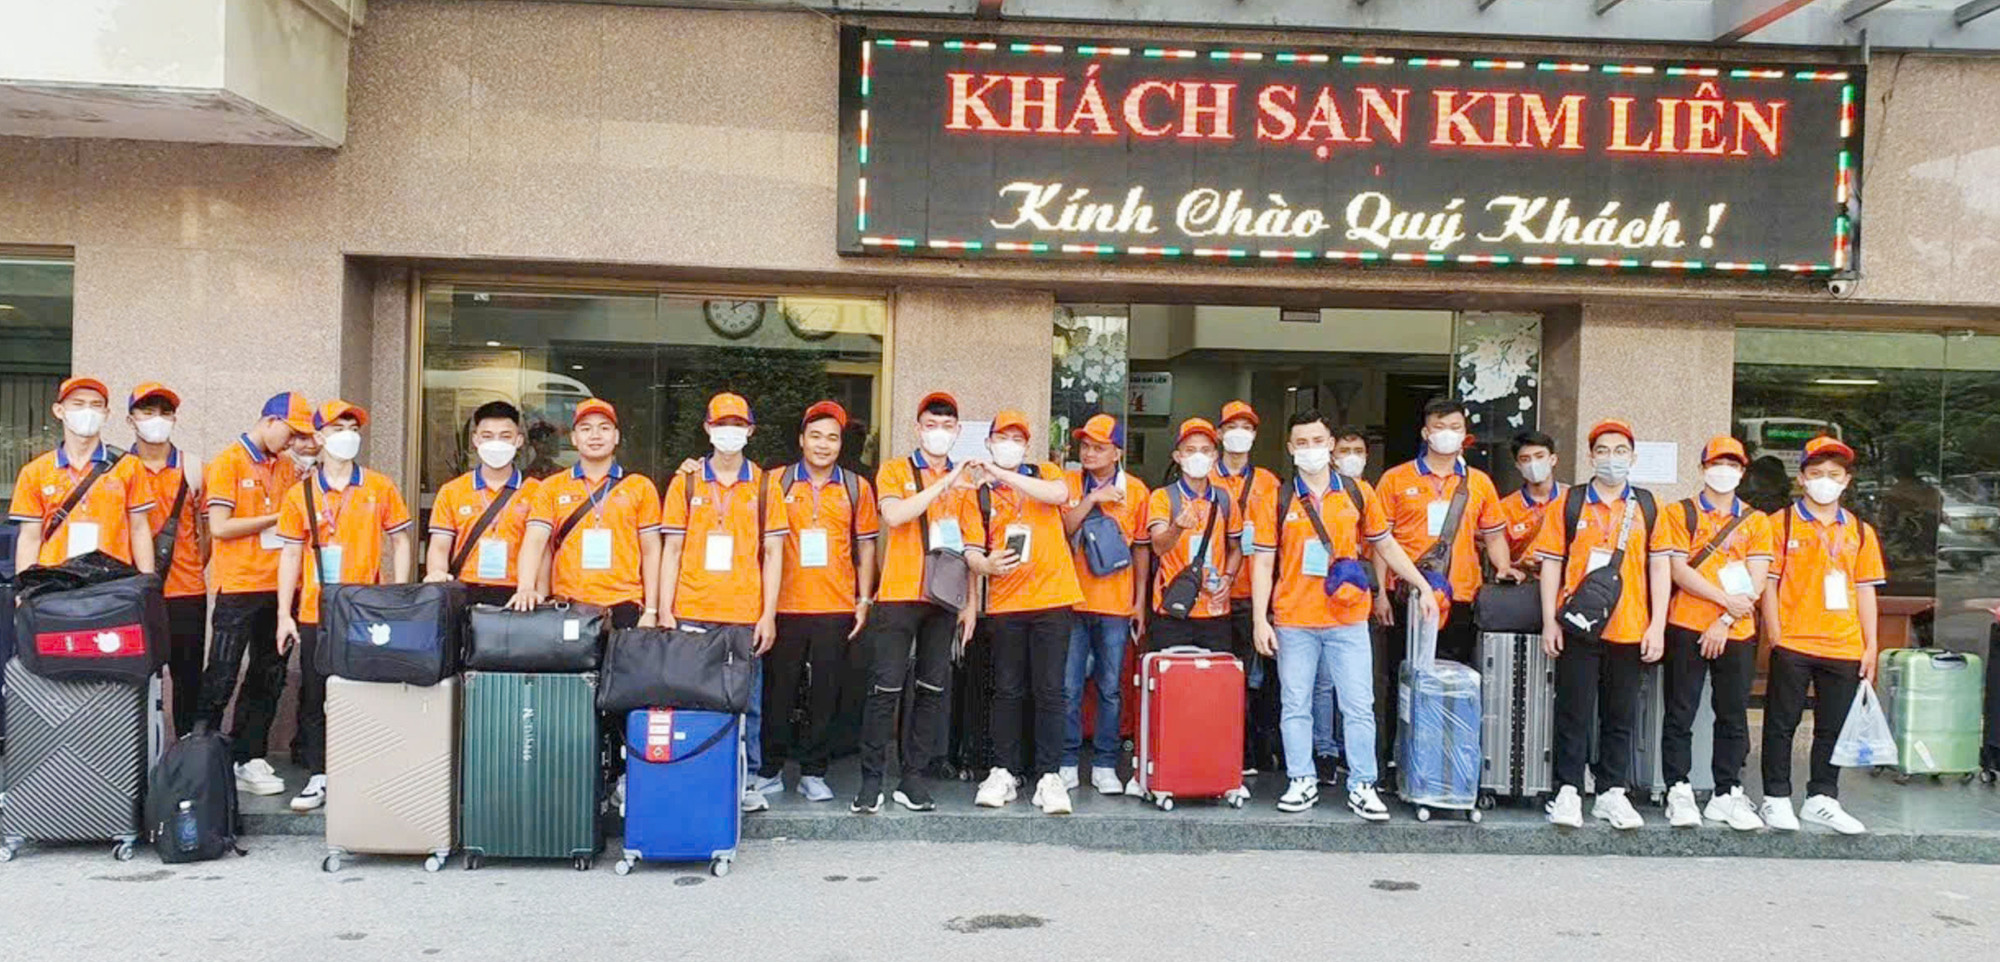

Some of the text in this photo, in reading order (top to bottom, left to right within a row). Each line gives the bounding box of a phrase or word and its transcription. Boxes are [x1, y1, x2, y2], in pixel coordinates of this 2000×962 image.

[944, 64, 1787, 159] KHÁCH SẠN KIM LIÊN
[989, 181, 1159, 235] Kính
[1174, 186, 1331, 237] Chào
[1345, 190, 1466, 250] Quý
[1476, 194, 1686, 249] Khách
